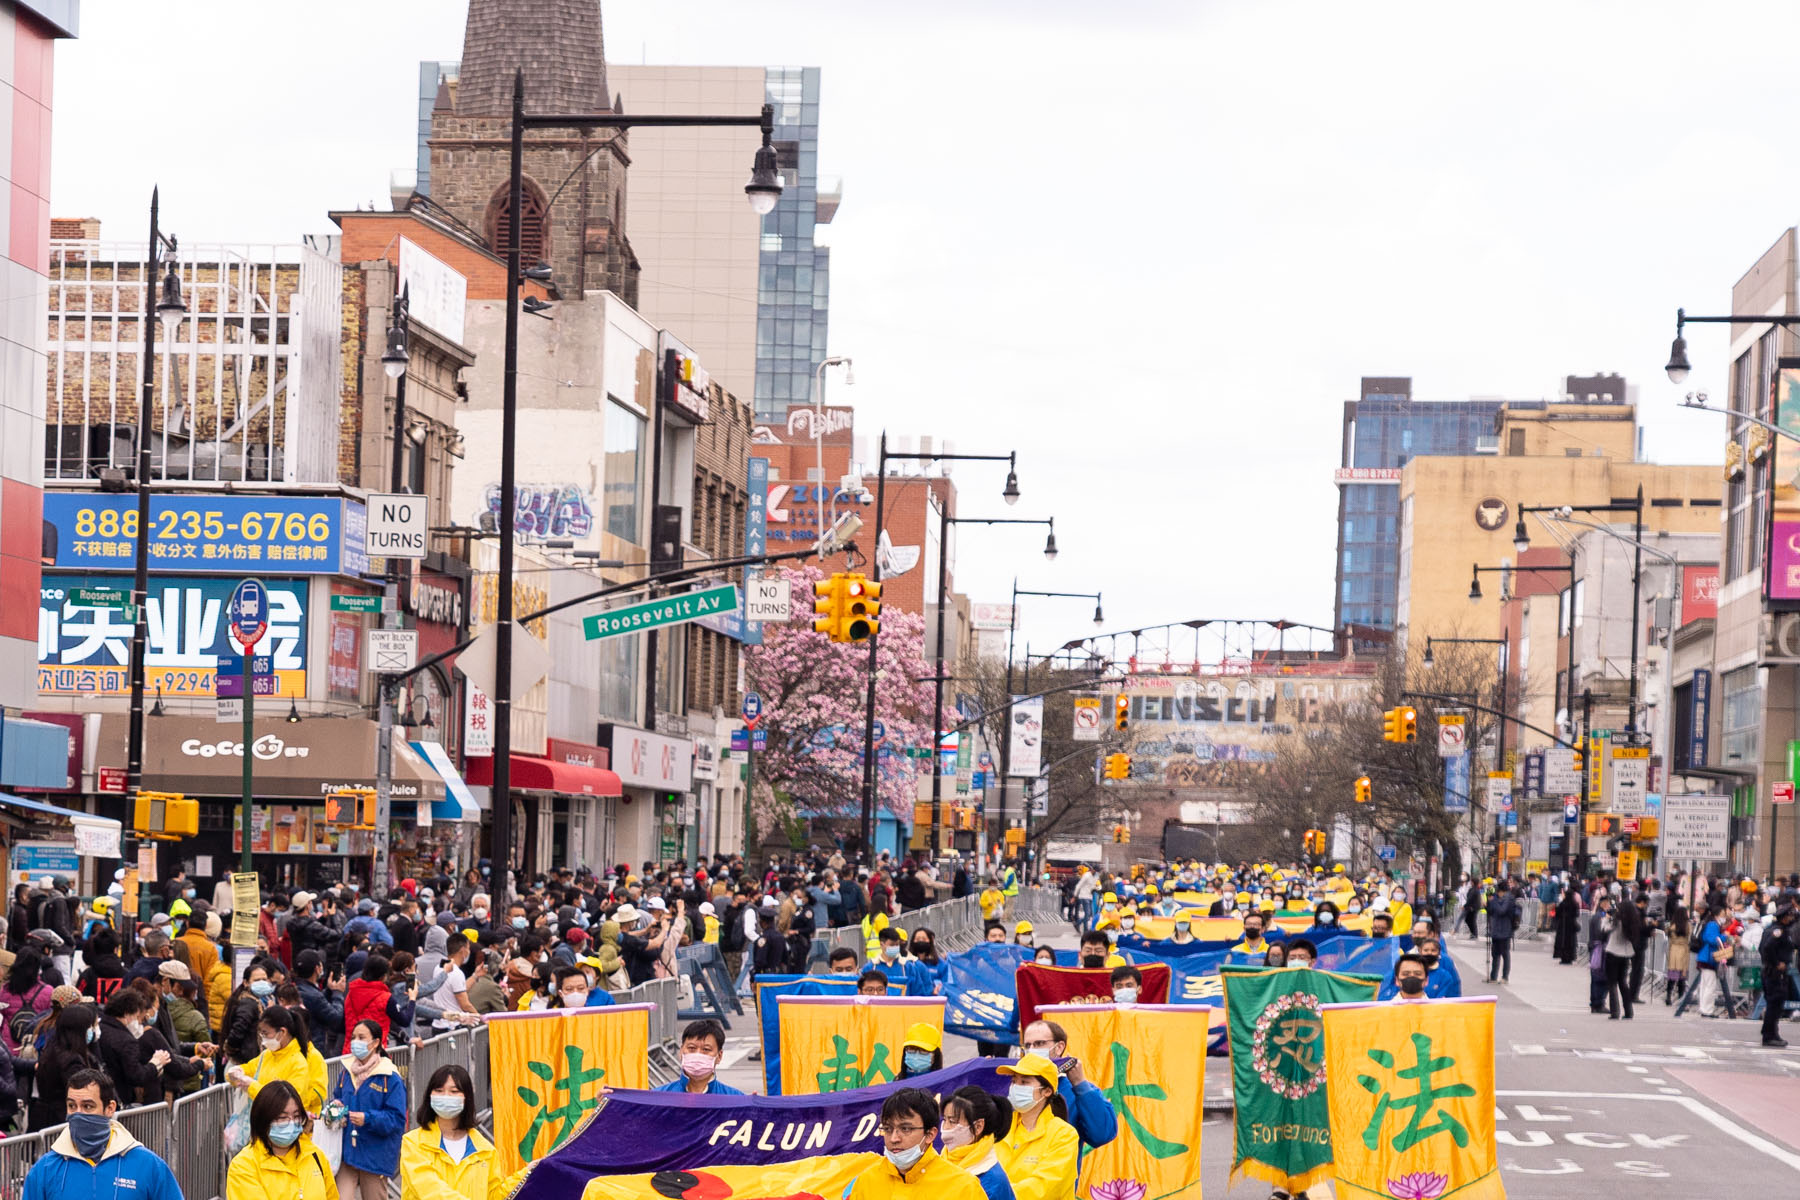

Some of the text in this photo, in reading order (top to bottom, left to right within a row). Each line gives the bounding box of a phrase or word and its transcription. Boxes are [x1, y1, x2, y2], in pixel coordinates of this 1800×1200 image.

[382, 503, 412, 524] NO
[74, 508, 330, 542] 888-235-6766
[369, 531, 423, 549] TURNS
[72, 541, 133, 558] 不获赔偿
[202, 543, 262, 561] 意外伤害
[267, 544, 328, 561] 赔偿律师
[79, 589, 123, 601] Roosevelt
[759, 586, 778, 598] NO
[338, 595, 376, 608] Roosevelt
[750, 603, 788, 614] TURNS
[597, 594, 722, 634] Roosevelt Av
[371, 633, 414, 642] DON'T BLOCK
[378, 643, 407, 651] THE BOX
[252, 657, 269, 673] Q65
[252, 677, 269, 694] Q65
[388, 783, 418, 796] Juice
[1271, 1017, 1324, 1075] 忍
[1082, 1041, 1189, 1160] 大
[1356, 1032, 1477, 1153] 法
[707, 1117, 833, 1154] FALUN
[1495, 1130, 1693, 1150] UCK
